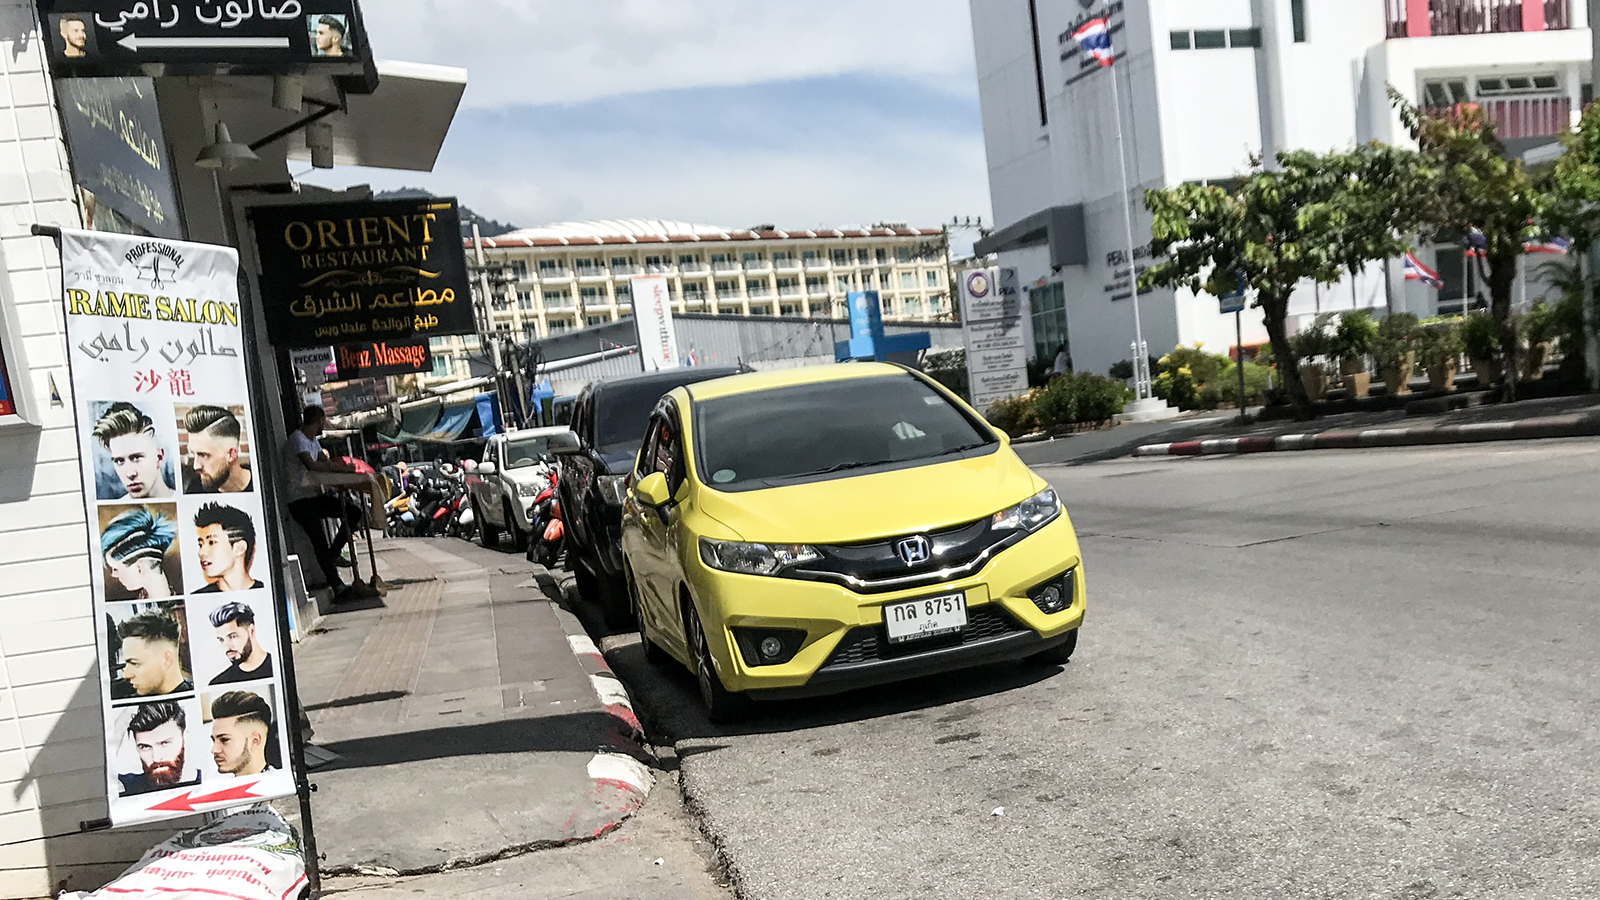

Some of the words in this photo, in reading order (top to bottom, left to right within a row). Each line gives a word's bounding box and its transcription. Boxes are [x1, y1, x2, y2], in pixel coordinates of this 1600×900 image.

[284, 213, 437, 251] ORIENT
[125, 241, 185, 268] PROFESSIONAL
[301, 245, 429, 269] RESTAURANT
[66, 288, 151, 319] RAME
[155, 296, 238, 325] SALON
[290, 290, 361, 318] الشرق
[368, 286, 455, 309] مطاعم
[414, 313, 438, 331] طبخ
[78, 320, 149, 363] رامي
[160, 325, 238, 366] صالون
[340, 346, 371, 369] Benz
[372, 341, 426, 368] Massage
[133, 368, 195, 397] 沙龍
[893, 603, 918, 622] กล
[924, 595, 961, 616] 8751
